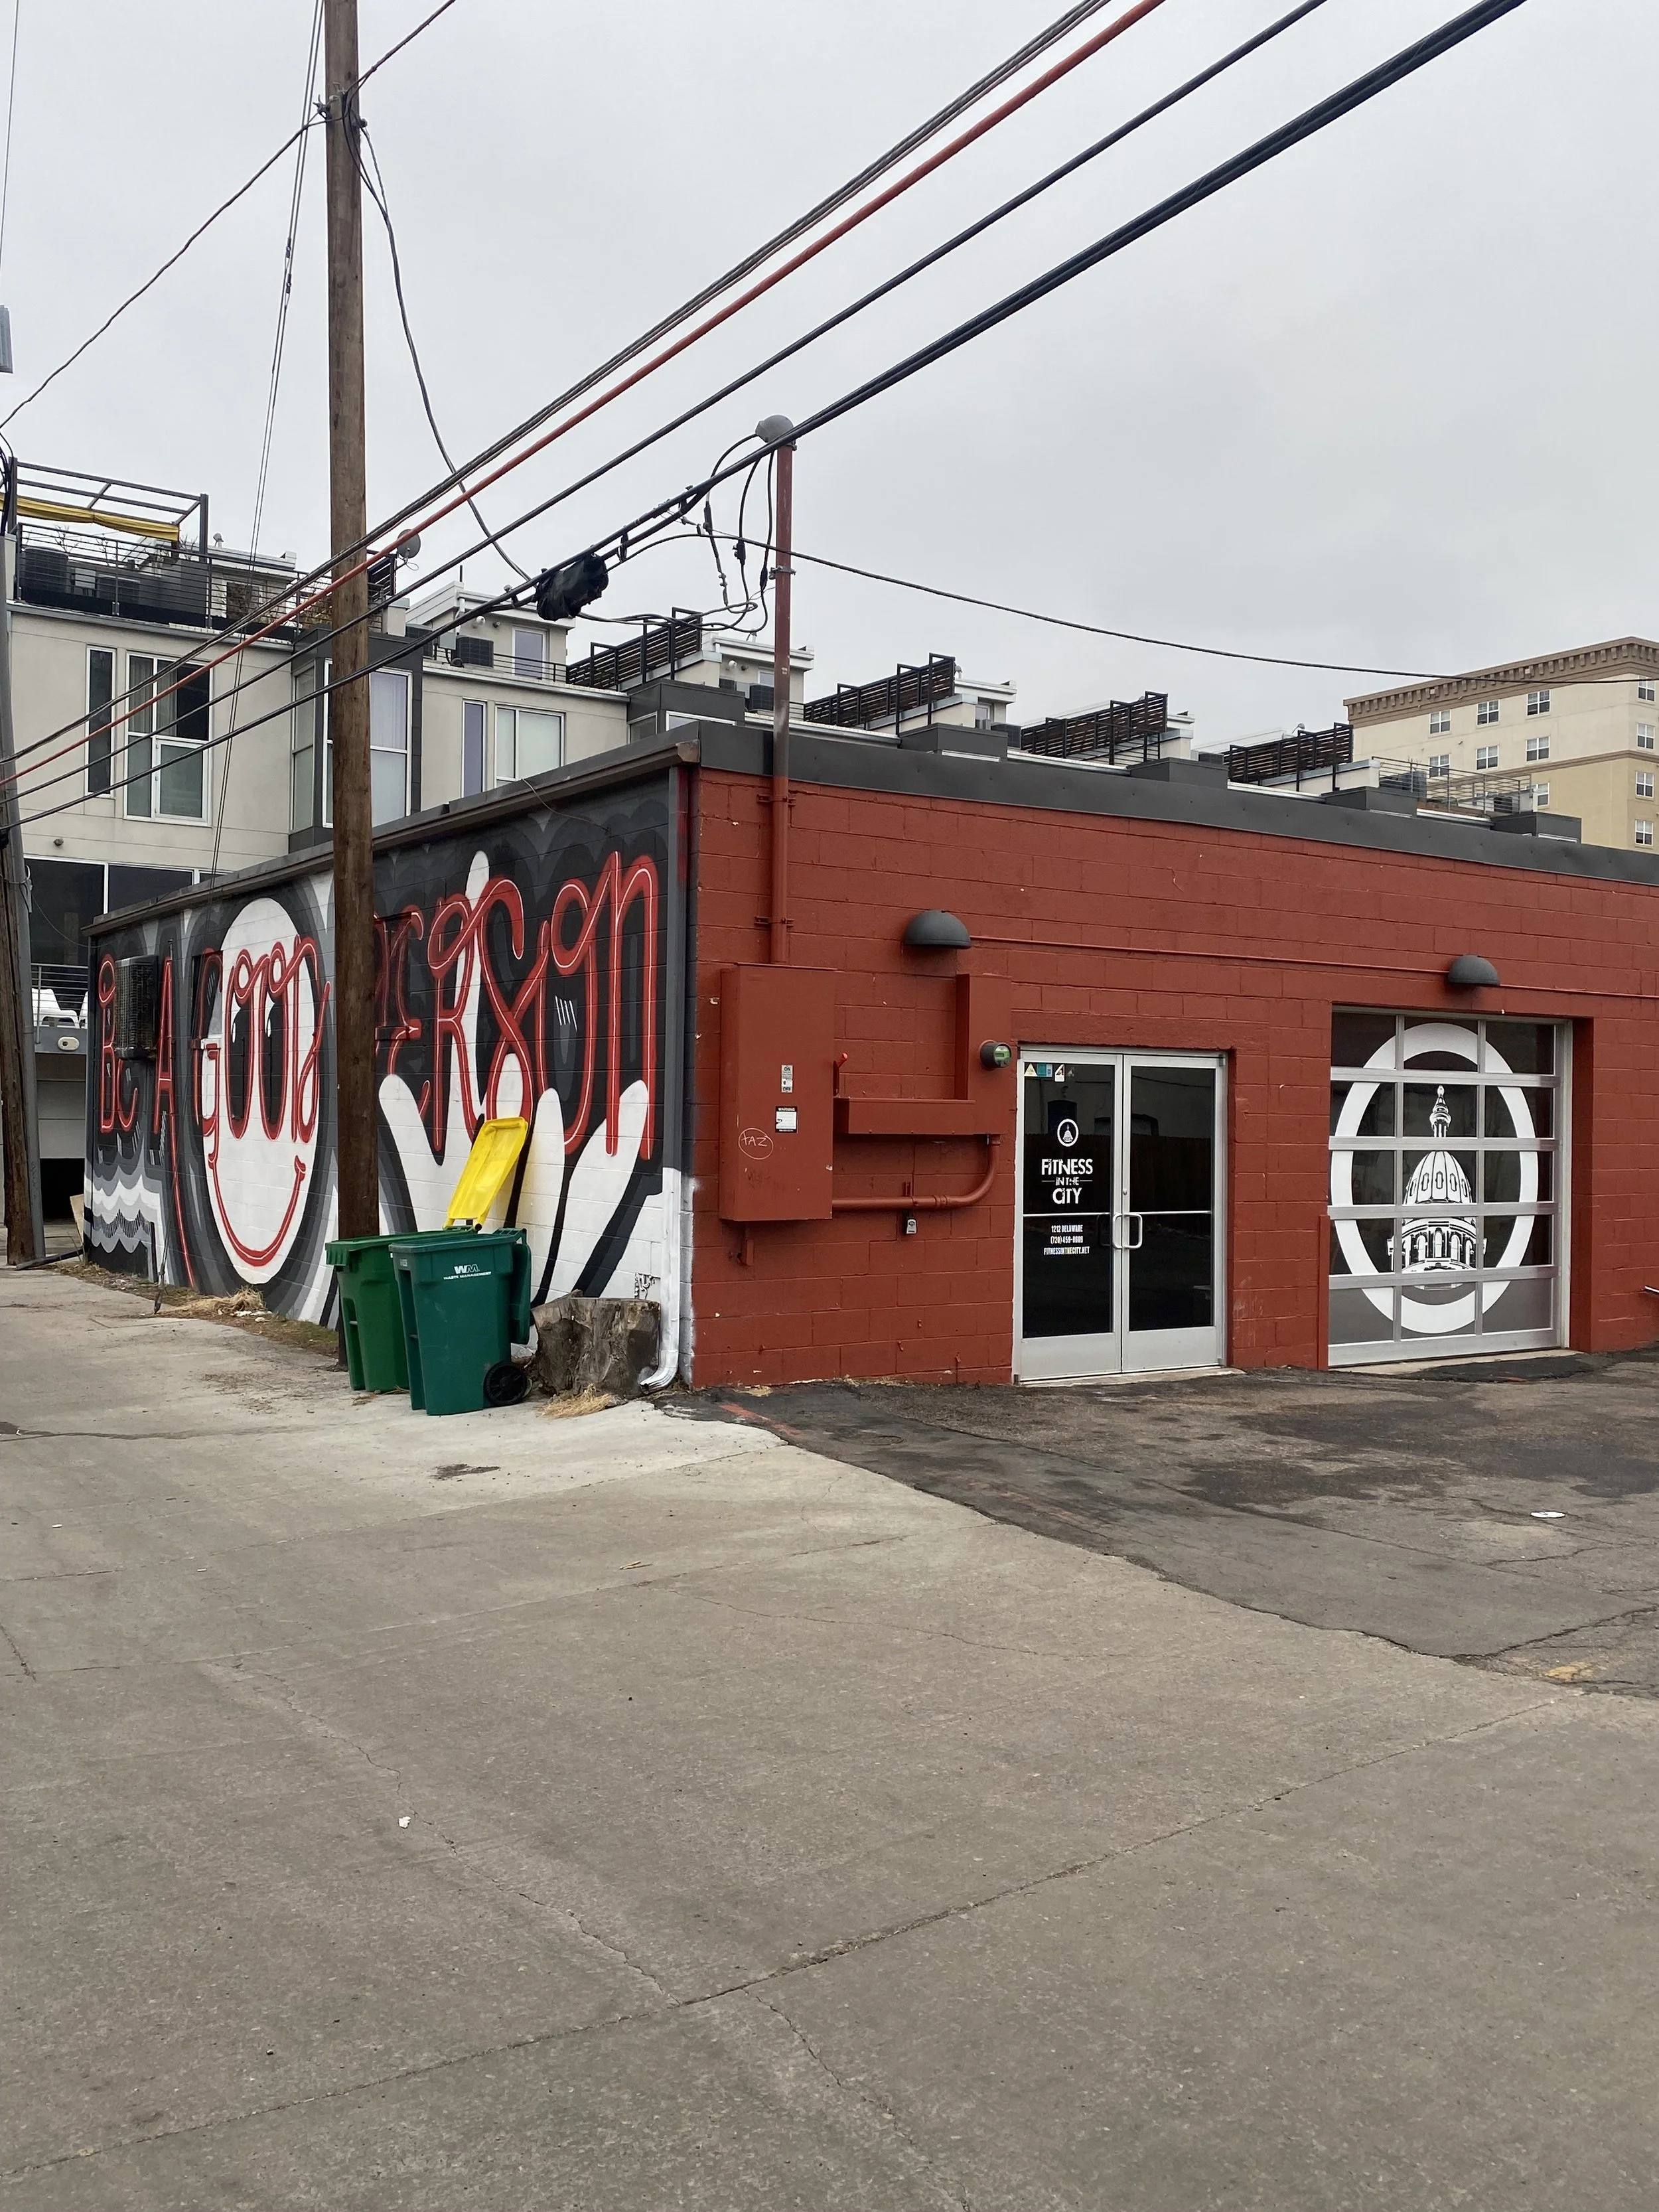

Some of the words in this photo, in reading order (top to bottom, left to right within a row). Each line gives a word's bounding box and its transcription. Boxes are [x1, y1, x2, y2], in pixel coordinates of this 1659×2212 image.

[374, 851, 659, 1160] ERSON
[1041, 1158, 1093, 1175] FITNESS
[1055, 1177, 1064, 1186] IN
[1065, 1177, 1080, 1186] THE
[1052, 1187, 1082, 1205] CITY
[1051, 1224, 1061, 1233] 1212
[1061, 1224, 1084, 1233] DELAWARE
[1050, 1235, 1062, 1244] (720)
[1043, 1246, 1090, 1256] FITNESSINTHECITY.NET
[454, 1264, 479, 1274] WM
